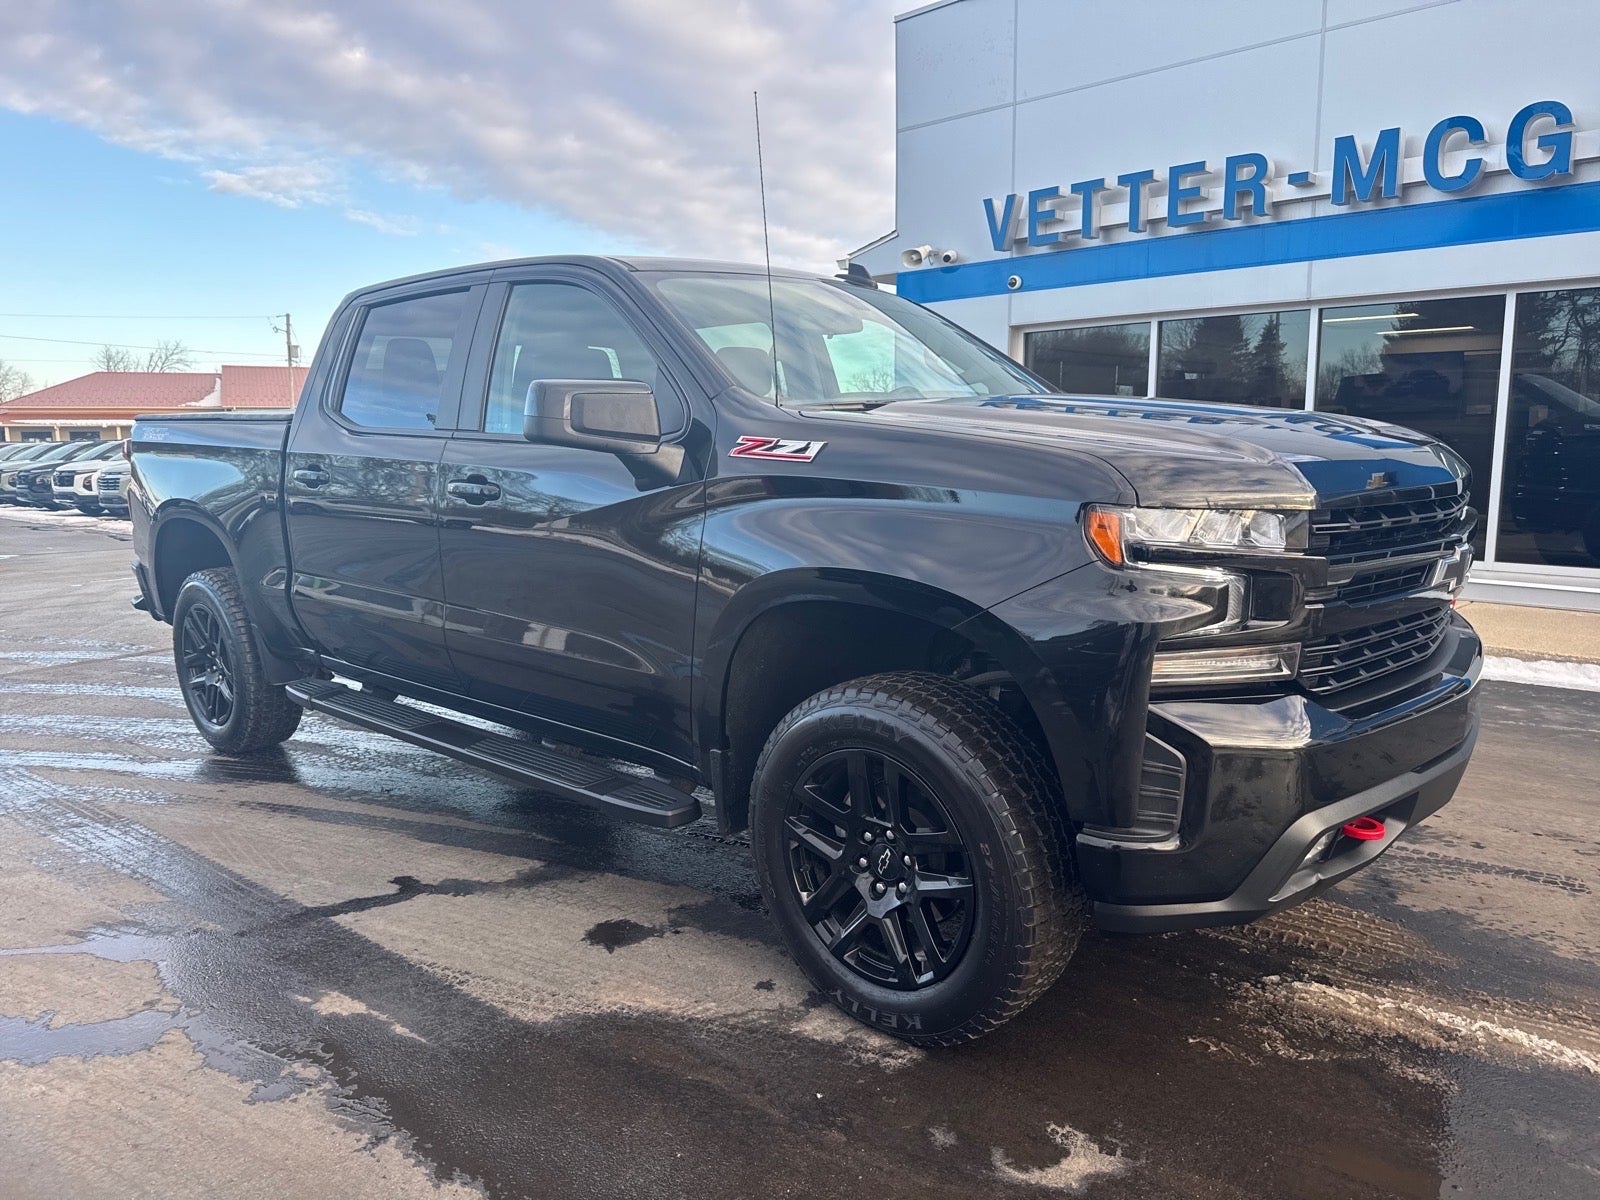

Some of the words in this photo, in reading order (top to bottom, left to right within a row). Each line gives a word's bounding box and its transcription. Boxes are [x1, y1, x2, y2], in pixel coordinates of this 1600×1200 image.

[728, 435, 828, 462] Z71
[817, 712, 912, 743] KELLY
[829, 989, 922, 1030] KELLY
